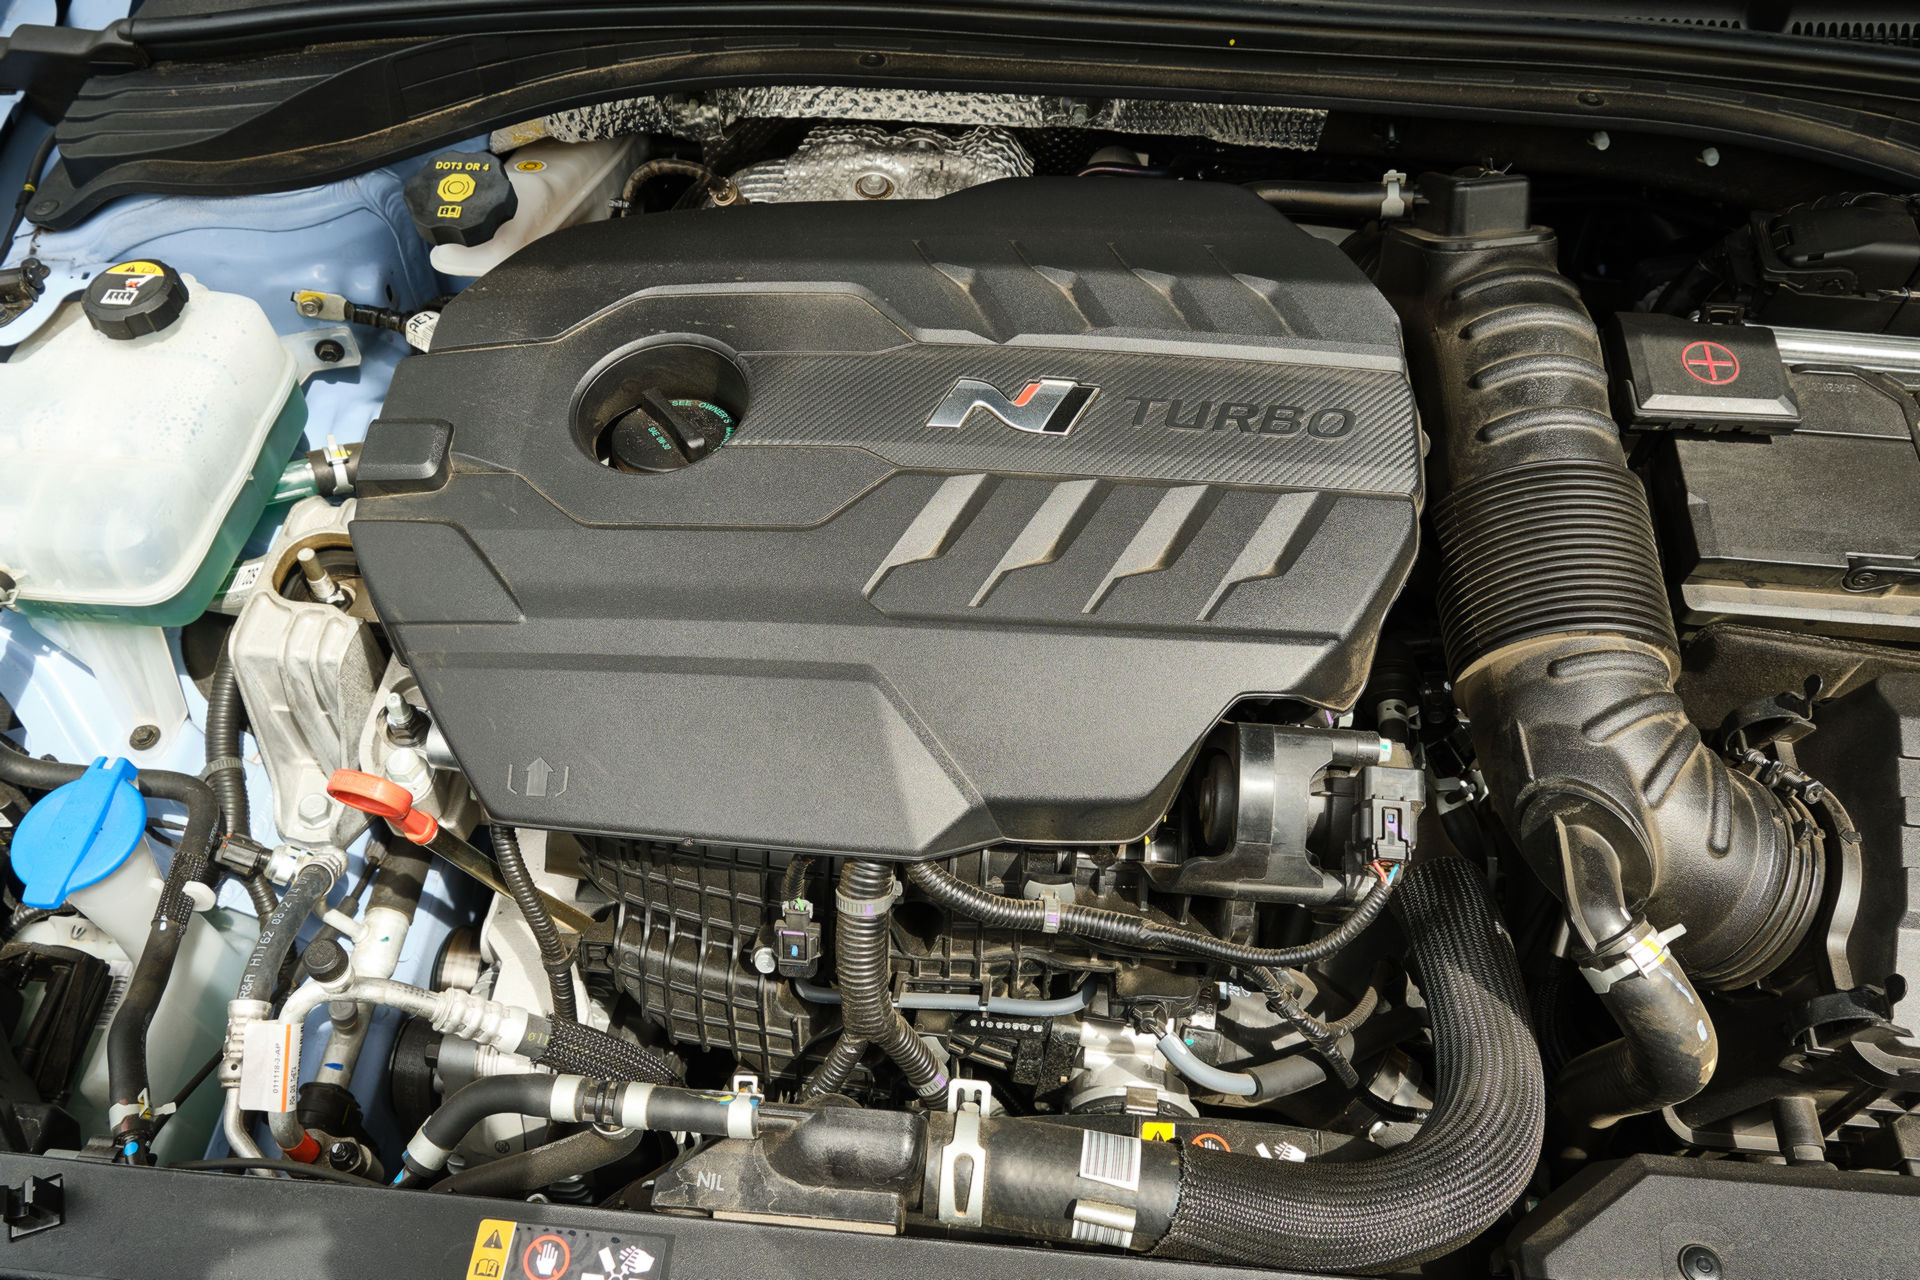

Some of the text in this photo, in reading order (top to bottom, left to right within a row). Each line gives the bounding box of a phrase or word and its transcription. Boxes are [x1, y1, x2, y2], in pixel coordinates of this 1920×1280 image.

[435, 161, 490, 171] DOT3 OR 4
[698, 401, 733, 424] OWNER'S
[1124, 397, 1357, 441] TURBO
